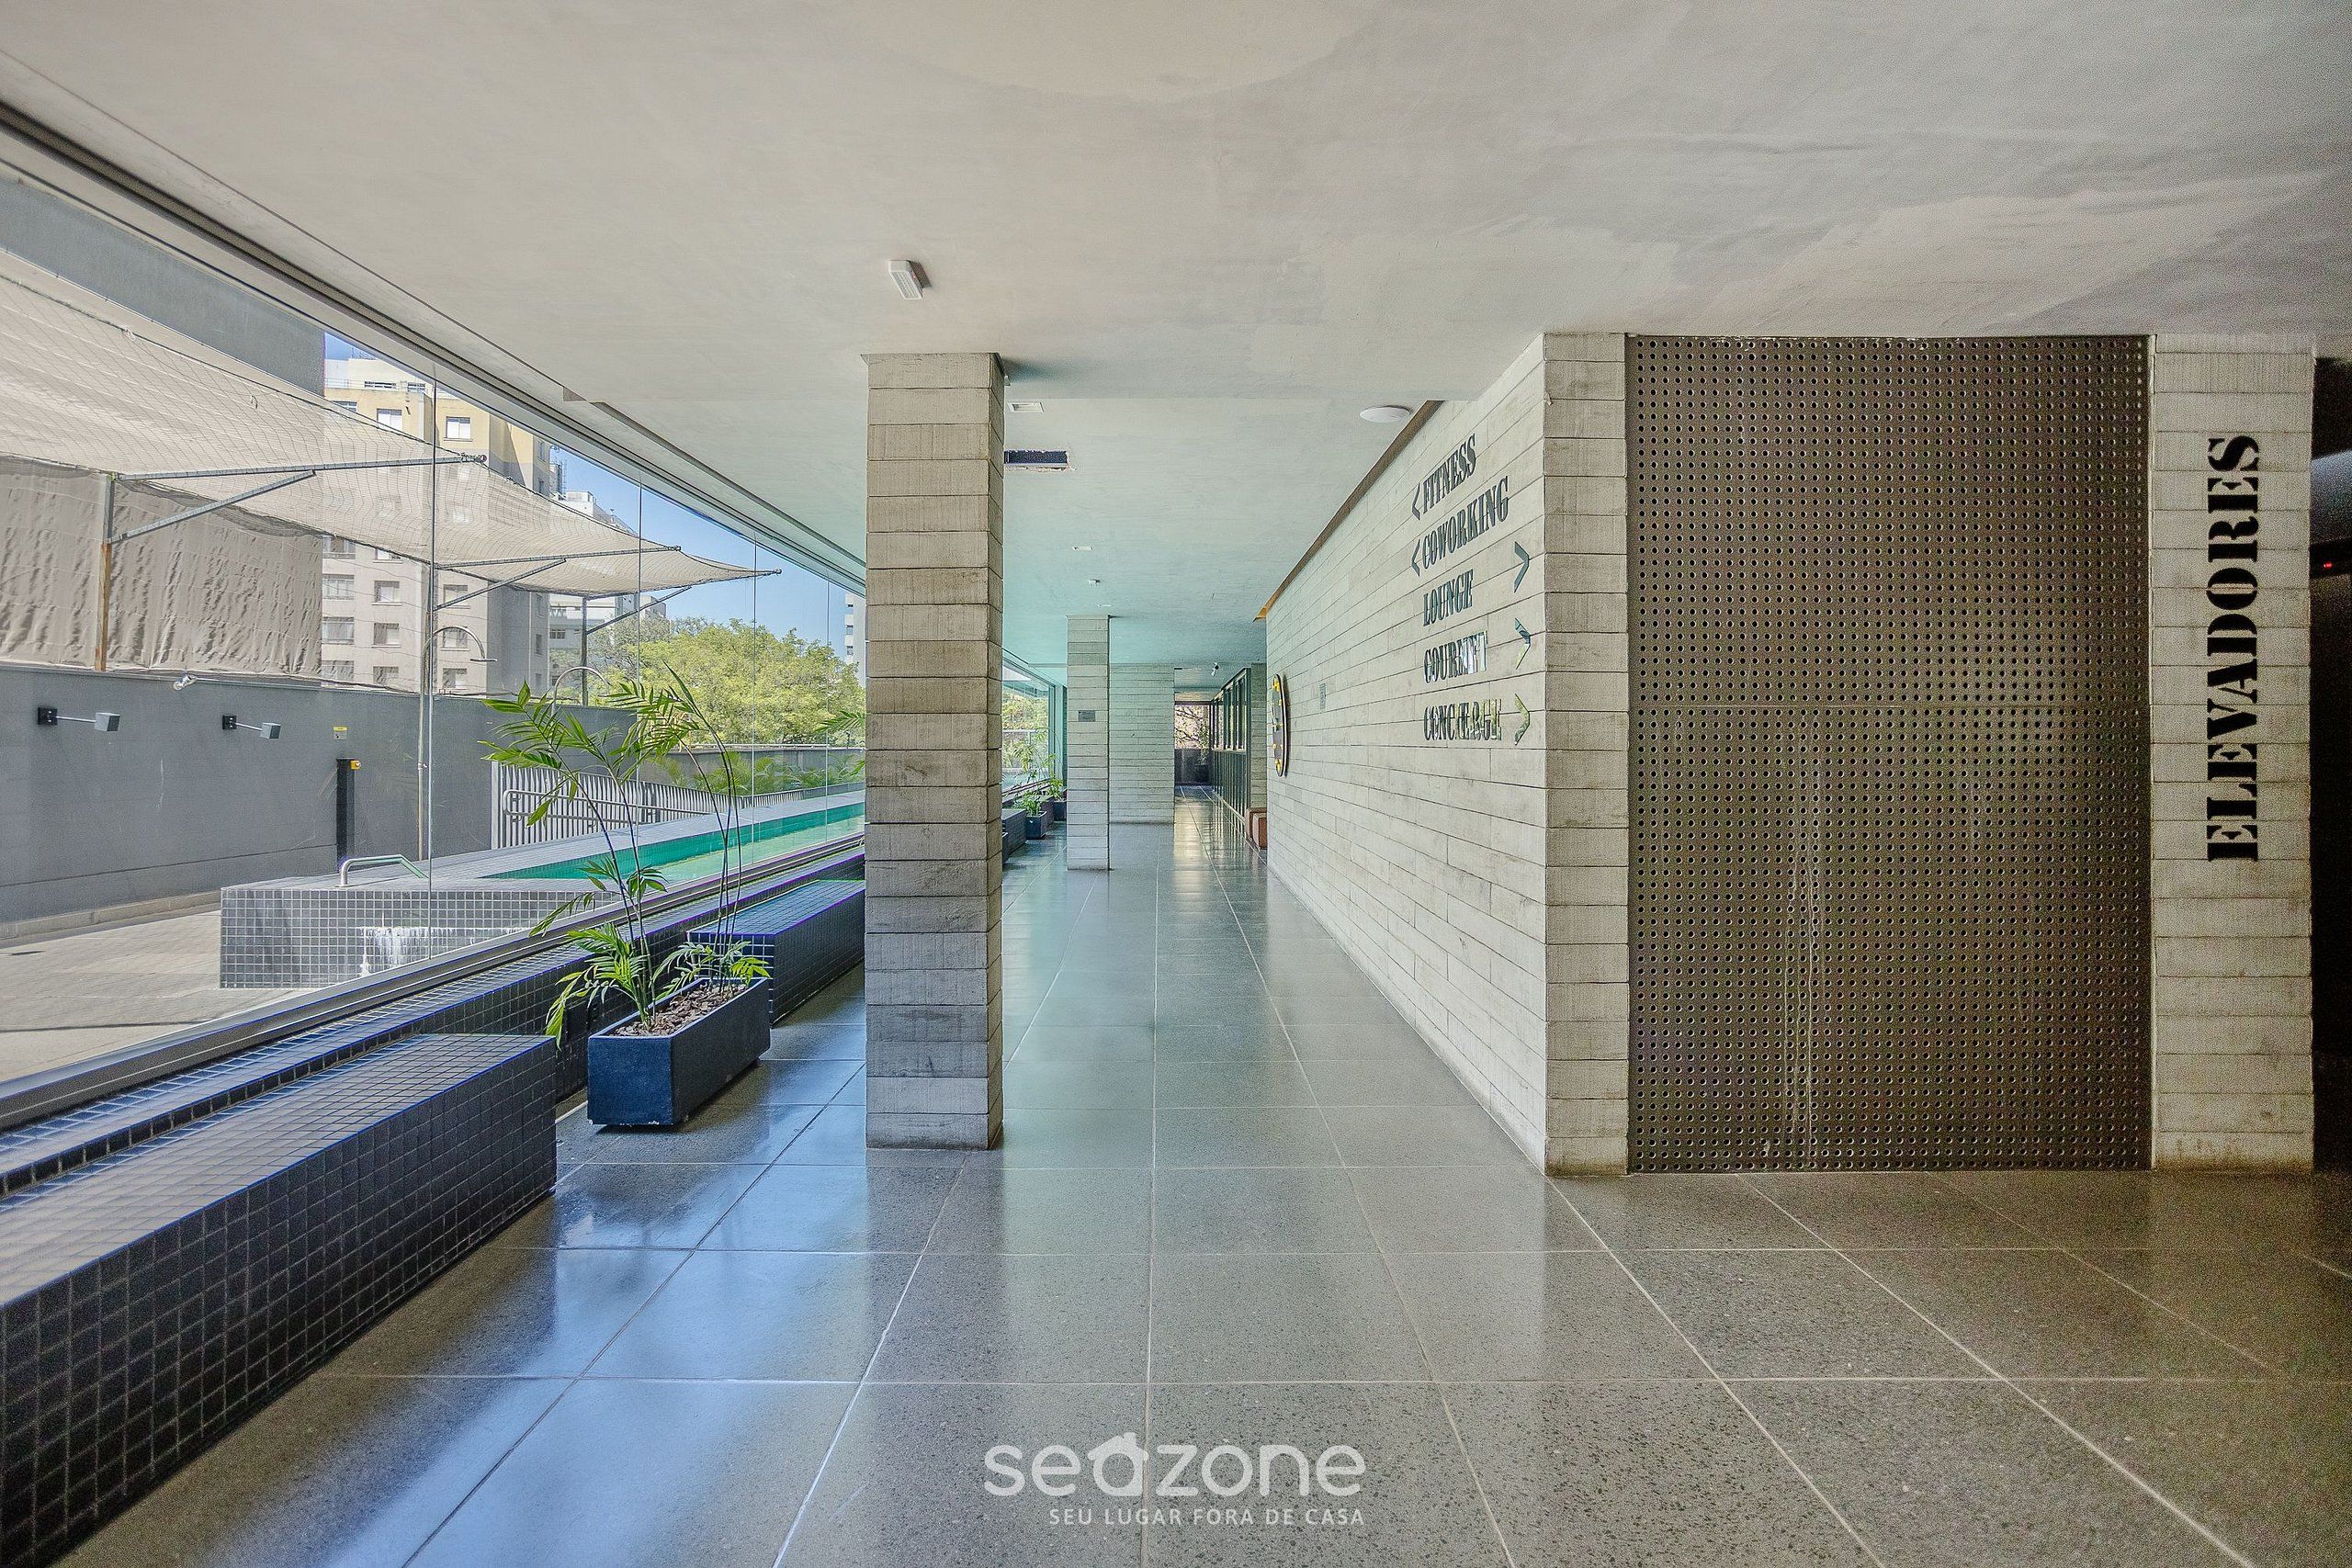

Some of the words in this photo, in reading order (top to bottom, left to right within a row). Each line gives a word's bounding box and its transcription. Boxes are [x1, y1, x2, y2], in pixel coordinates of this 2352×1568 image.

[1422, 433, 1476, 514] FITNESS
[1422, 475, 1509, 570] COWORKING
[1423, 569, 1474, 627] LOUNGE
[2206, 434, 2259, 863] ELEVADORES
[1423, 698, 1502, 741] CONCIERGE
